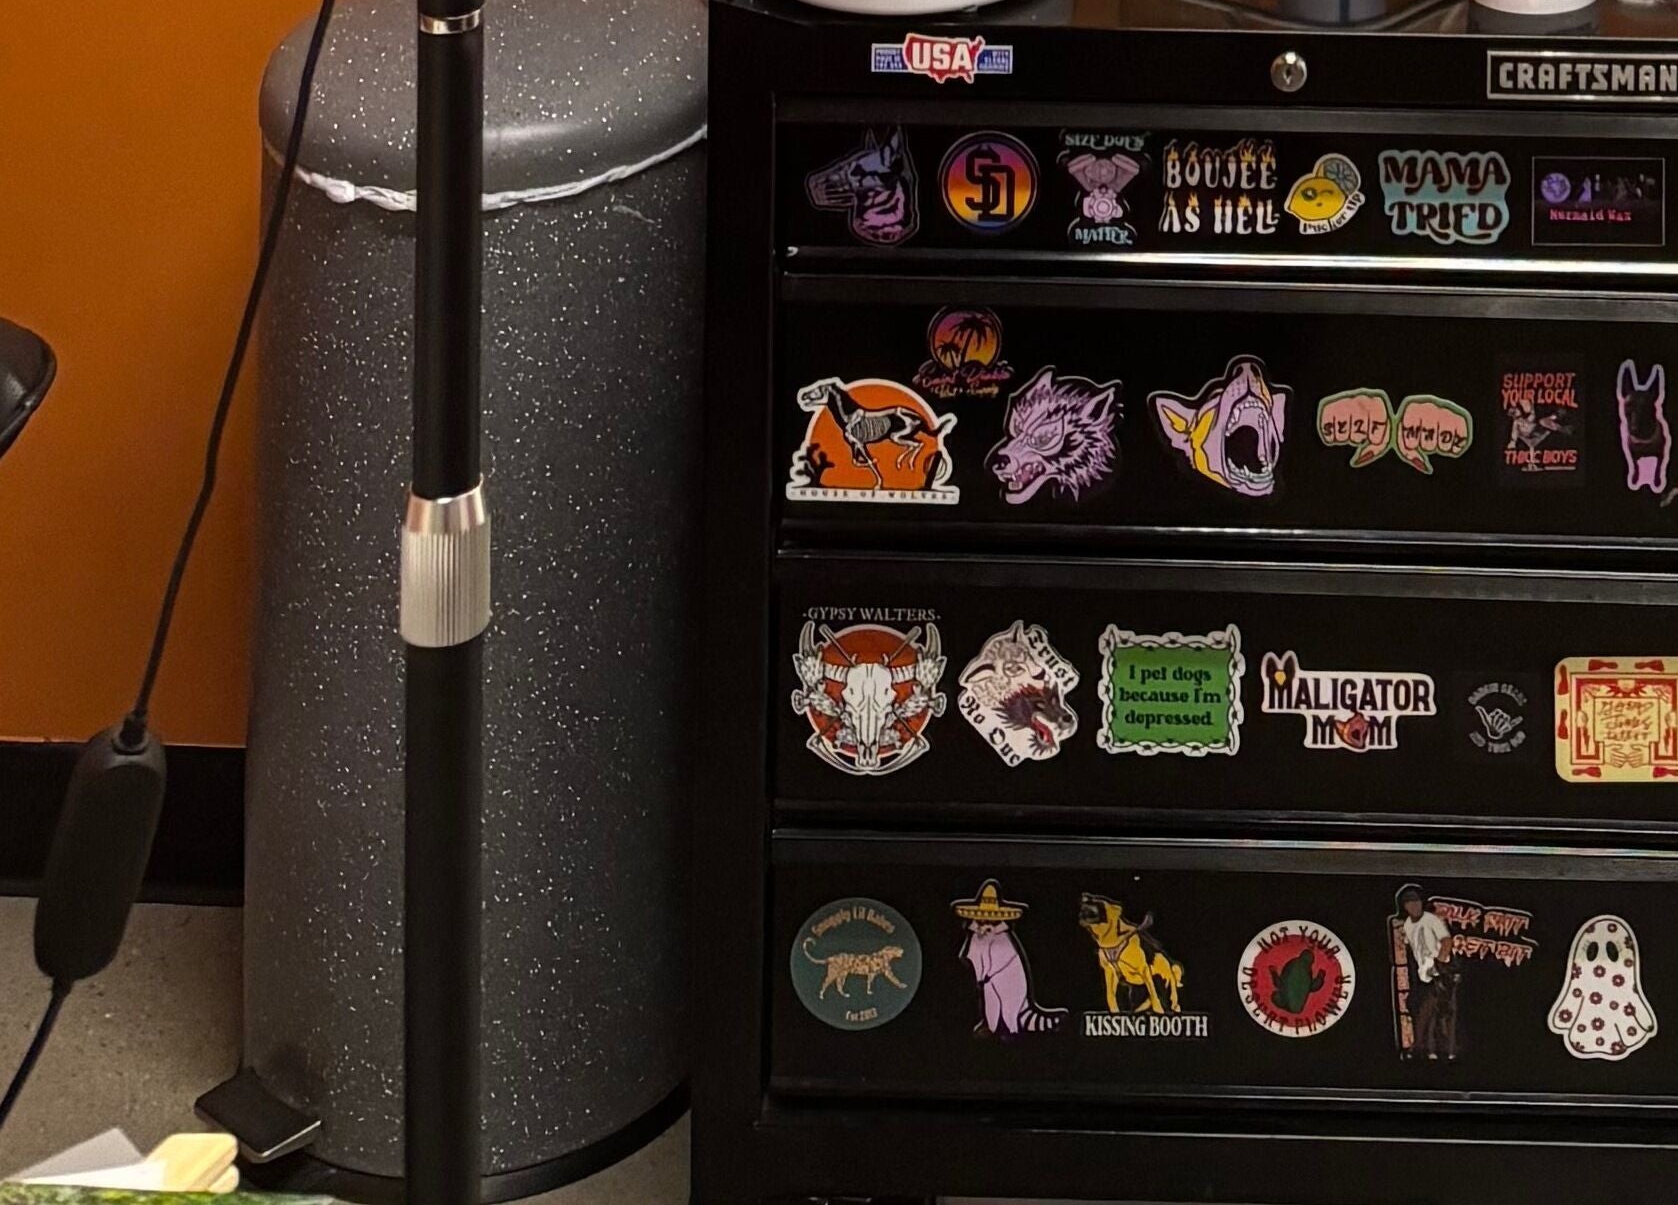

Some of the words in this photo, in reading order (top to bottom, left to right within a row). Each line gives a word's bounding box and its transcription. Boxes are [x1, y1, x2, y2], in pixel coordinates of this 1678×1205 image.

[911, 42, 973, 71] USA
[1499, 62, 1678, 92] CRAFTSMAN
[1164, 146, 1277, 189] BOUJEE
[1382, 155, 1508, 196] MAMA
[1161, 195, 1201, 234] AS
[1213, 195, 1278, 235] HELL
[1388, 201, 1504, 239] TRIED
[1502, 372, 1577, 389] SUPPORT
[1502, 388, 1535, 409] YOUR
[1537, 388, 1579, 409] LOCAL
[1542, 450, 1578, 464] BOYS
[807, 606, 856, 621] GYPSY
[860, 606, 937, 622] WALTERS
[1128, 664, 1136, 680] I
[1140, 666, 1168, 685] pet
[1172, 666, 1212, 687] dogs
[1118, 687, 1190, 703] because
[1267, 668, 1431, 713] MALIGATOR
[1256, 926, 1289, 954] NOT
[1298, 925, 1341, 959] YOUR
[1084, 1015, 1147, 1038] KISSING
[1148, 1015, 1210, 1038] BOOTH
